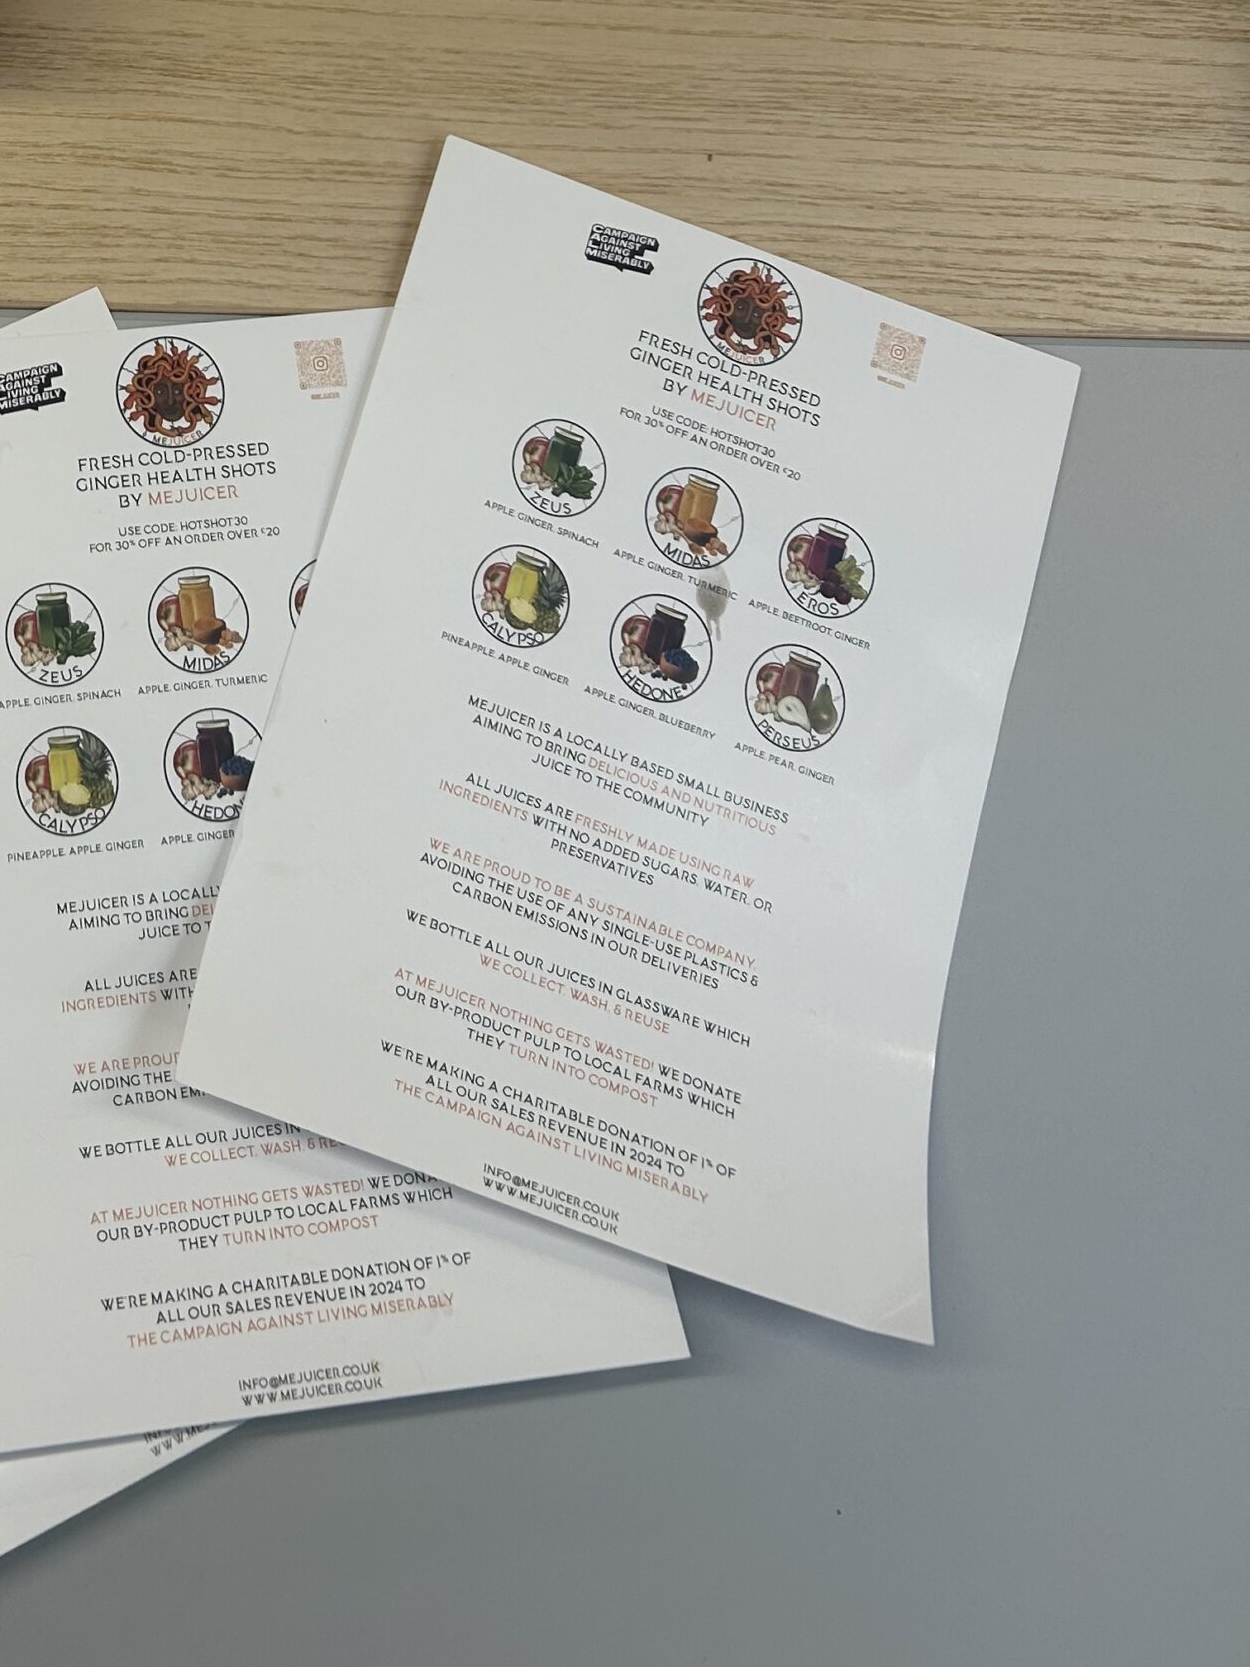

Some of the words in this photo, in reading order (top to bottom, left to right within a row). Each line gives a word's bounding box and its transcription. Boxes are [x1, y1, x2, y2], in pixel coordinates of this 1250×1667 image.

[588, 240, 632, 256] LIVING
[590, 232, 642, 252] AGAINST
[592, 224, 656, 246] CAMPAIGN
[586, 248, 650, 270] MISERABLY
[638, 329, 693, 359] FRESH
[696, 351, 820, 406] COLD-PRESSED
[629, 346, 693, 380] GINGER
[697, 370, 764, 406] HEALTH
[765, 397, 820, 426] SHOTS
[661, 377, 689, 396] BY
[690, 387, 776, 431] MEJUICER
[619, 406, 641, 422] FOR
[665, 424, 688, 438] OFF
[689, 433, 708, 447] AN
[708, 440, 748, 462] ORDER
[749, 455, 780, 473] OVER
[651, 405, 674, 421] USE
[709, 426, 775, 458] HOTSHOT30
[77, 453, 134, 471] FRESH
[137, 442, 269, 466] COLD-PRESSED
[75, 473, 142, 492] GINGER
[146, 465, 216, 485] HEALTH
[220, 460, 276, 478] SHOTS
[118, 492, 142, 508] BY
[147, 484, 238, 506] MEJUICER
[530, 491, 573, 516] ZEUS
[662, 540, 711, 569] MIDAS
[796, 591, 841, 615] EROS
[480, 612, 547, 646] CALYPSO
[39, 666, 84, 684] ZEUS
[182, 651, 232, 671] MIDAS
[621, 669, 682, 702] HEDONE
[757, 718, 821, 751] PERSEUS
[467, 694, 535, 729] MEJUICER
[537, 720, 551, 734] IS
[552, 727, 562, 739] A
[565, 731, 628, 762] LOCALLY
[630, 755, 674, 780] BASED
[675, 772, 719, 798] SMALL
[723, 790, 788, 823] BUSINESS
[472, 713, 522, 740] AIMING
[525, 731, 543, 747] TO
[544, 739, 587, 764] BRING
[587, 756, 658, 791] DELICIOUS
[660, 784, 691, 803] AND
[693, 796, 775, 835] NUTRITIOUS
[531, 752, 572, 776] JUICE
[574, 767, 592, 783] TO
[595, 775, 622, 795] THE
[623, 786, 709, 826] COMMUNITY
[38, 807, 107, 834] CALYPSO
[550, 837, 654, 885] PRESERVATIVES
[394, 1078, 422, 1099] THE
[424, 1090, 502, 1128] CAMPAIGN
[505, 1118, 571, 1153] AGAINST
[573, 1144, 622, 1172] LIVING
[625, 1163, 708, 1203] MISERABLY
[177, 1232, 218, 1251] THEY
[222, 1227, 266, 1245] TURN
[268, 1223, 304, 1240] INTO
[307, 1214, 378, 1235] COMPOST
